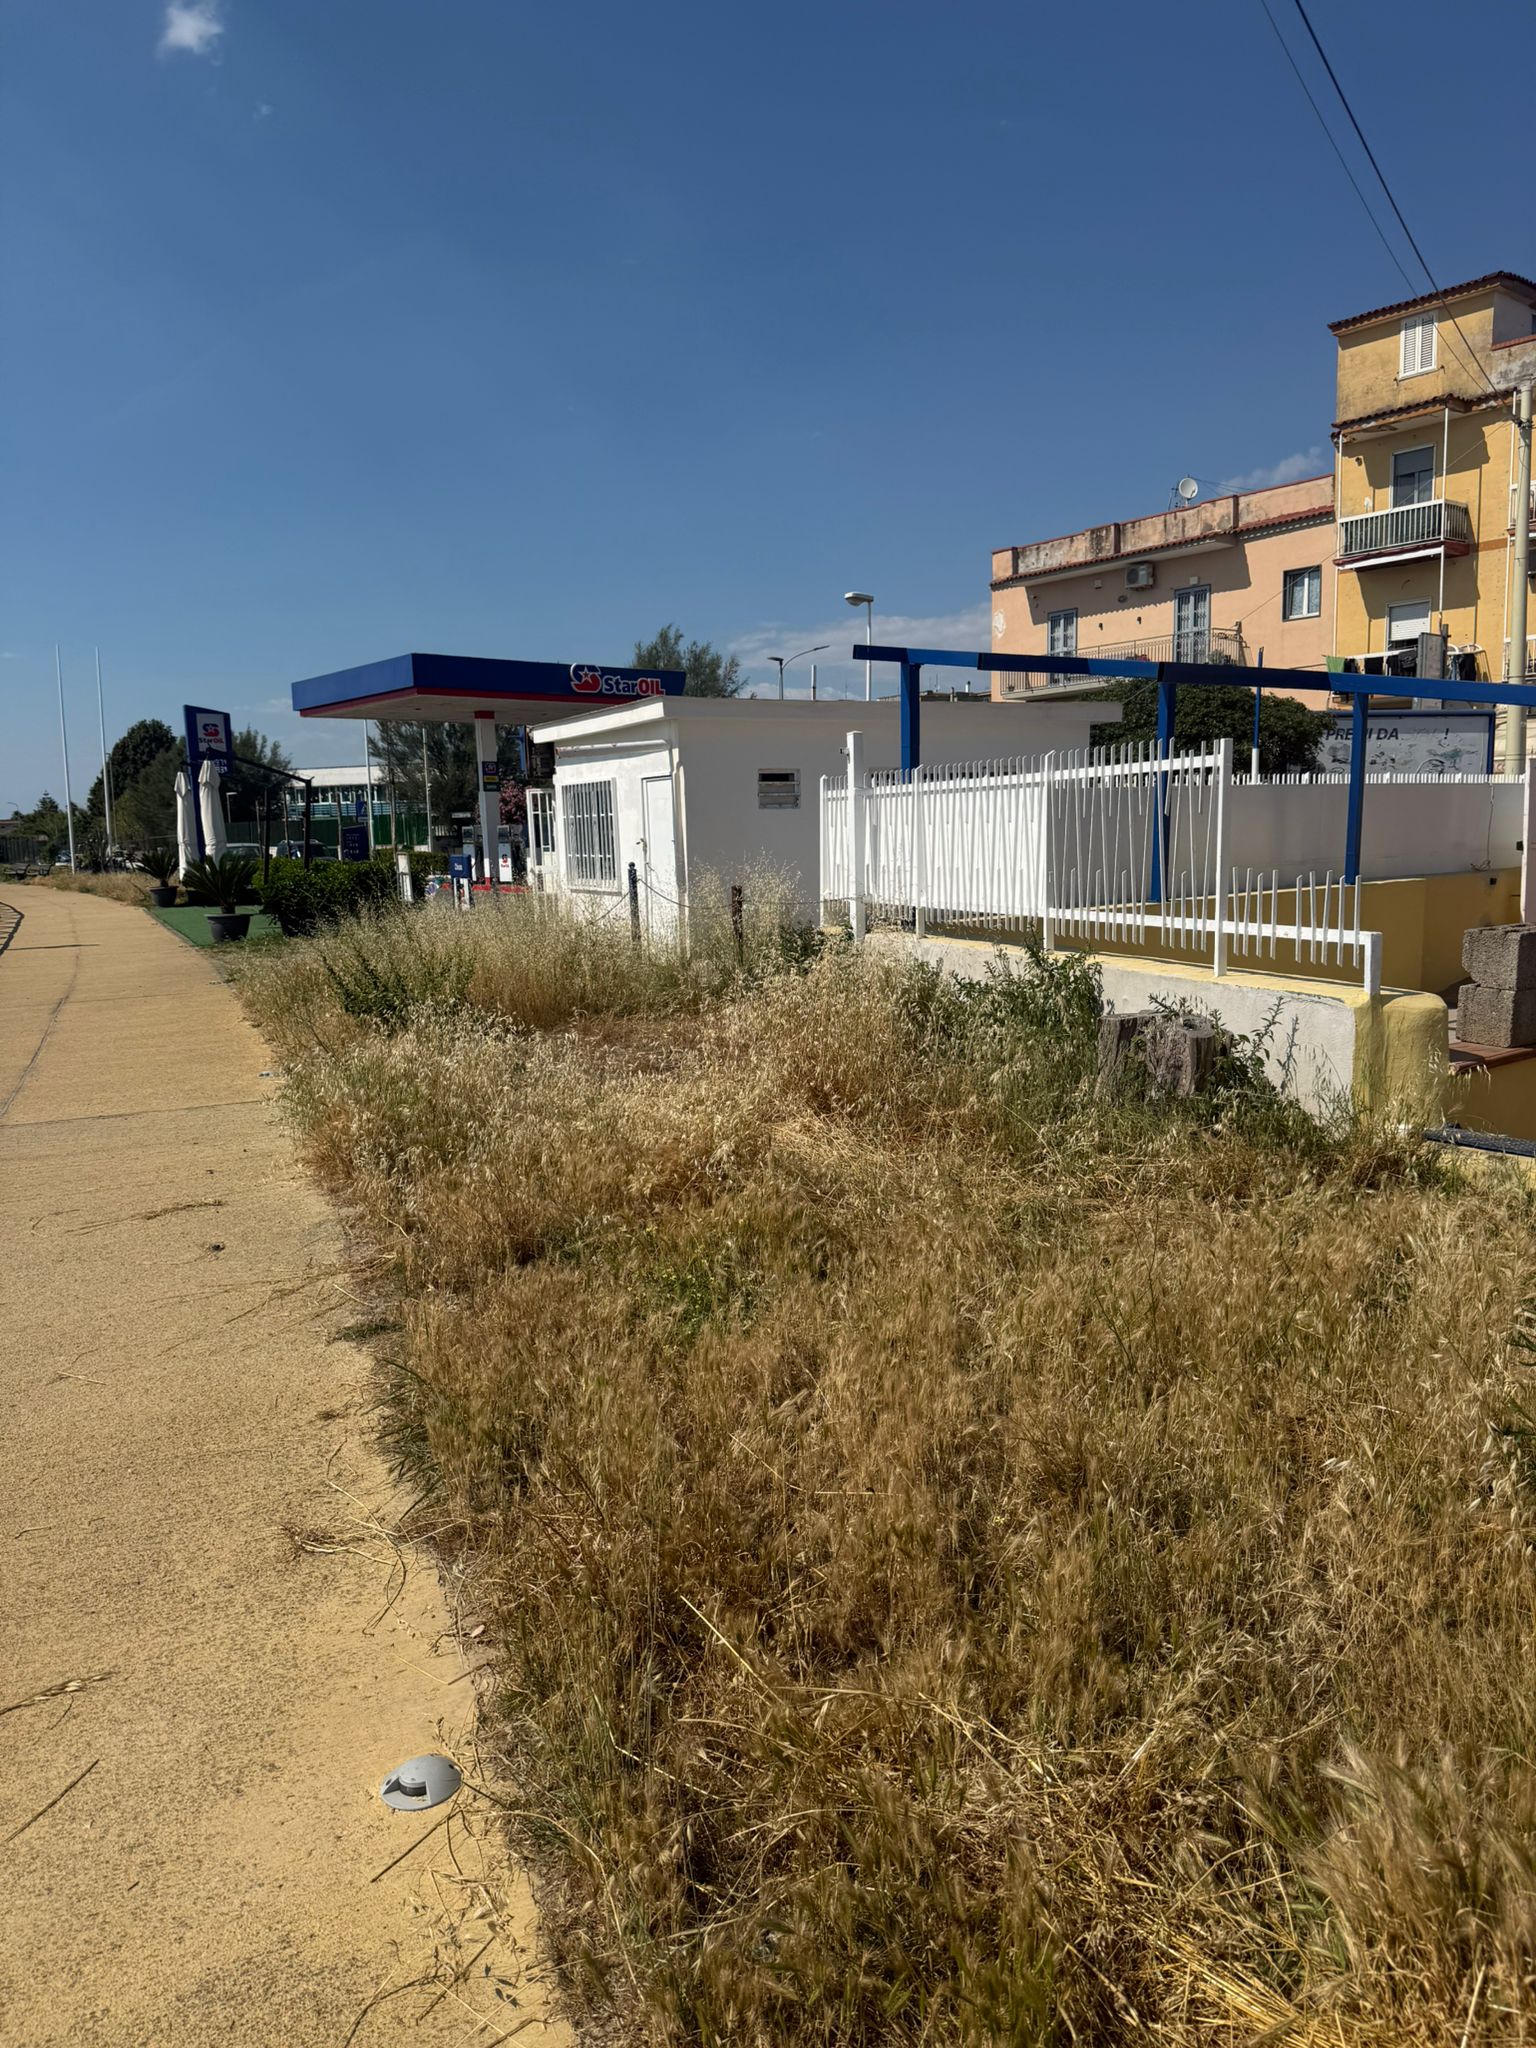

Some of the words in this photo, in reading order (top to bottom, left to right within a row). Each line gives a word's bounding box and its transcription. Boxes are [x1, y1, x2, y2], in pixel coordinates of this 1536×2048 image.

[602, 675, 665, 696] StarOIL
[1325, 727, 1373, 741] PREI
[1376, 727, 1399, 740] DA
